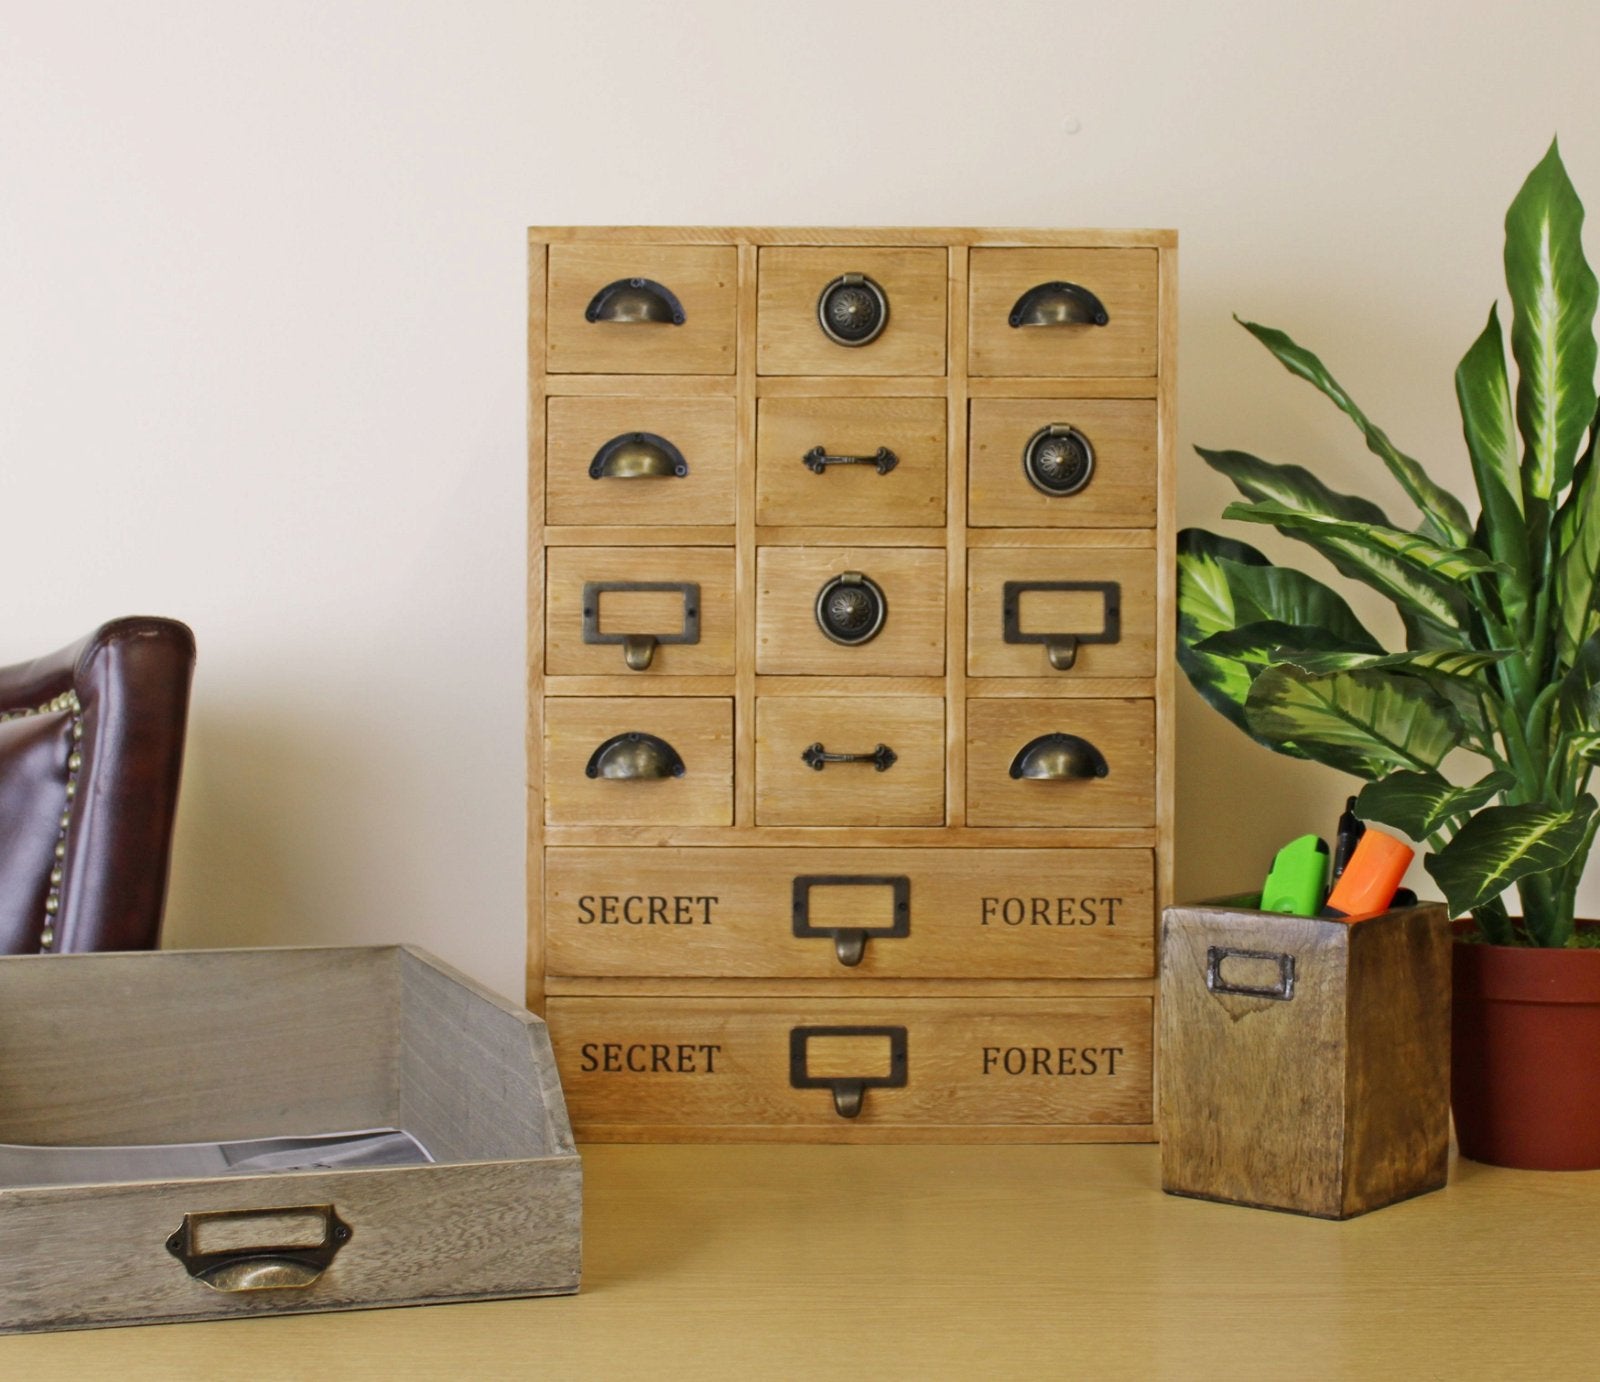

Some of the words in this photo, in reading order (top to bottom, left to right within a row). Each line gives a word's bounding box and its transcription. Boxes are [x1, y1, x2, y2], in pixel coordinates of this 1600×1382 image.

[577, 895, 720, 926] SECRET
[980, 896, 1124, 927] FOREST
[580, 1042, 723, 1074] SECRET
[981, 1046, 1125, 1076] FOREST
